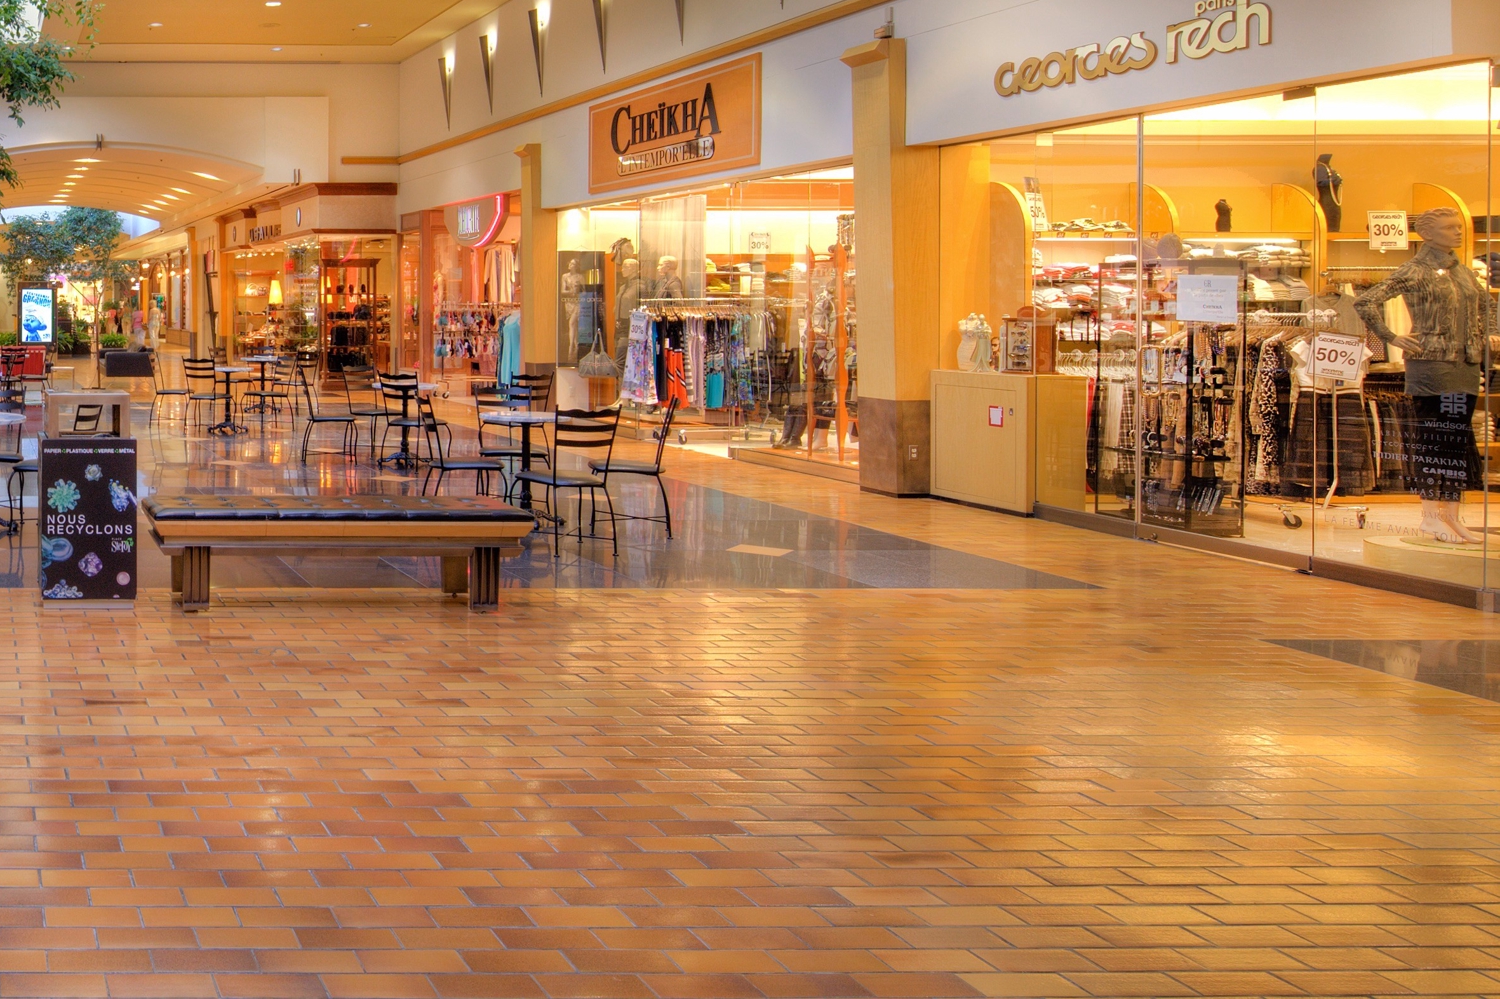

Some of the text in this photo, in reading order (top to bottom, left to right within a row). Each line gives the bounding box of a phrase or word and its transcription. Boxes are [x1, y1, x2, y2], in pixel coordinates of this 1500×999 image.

[1373, 223, 1404, 237] 30%
[1315, 347, 1356, 366] 50%
[118, 446, 135, 454] MÉTAL
[1411, 455, 1467, 467] PARAKIAN
[1422, 467, 1467, 477] CAMBIO
[47, 514, 86, 524] NOUS
[47, 524, 133, 535] RECYCLONS
[1324, 514, 1466, 544] LA FEMME AVANT TOUT
